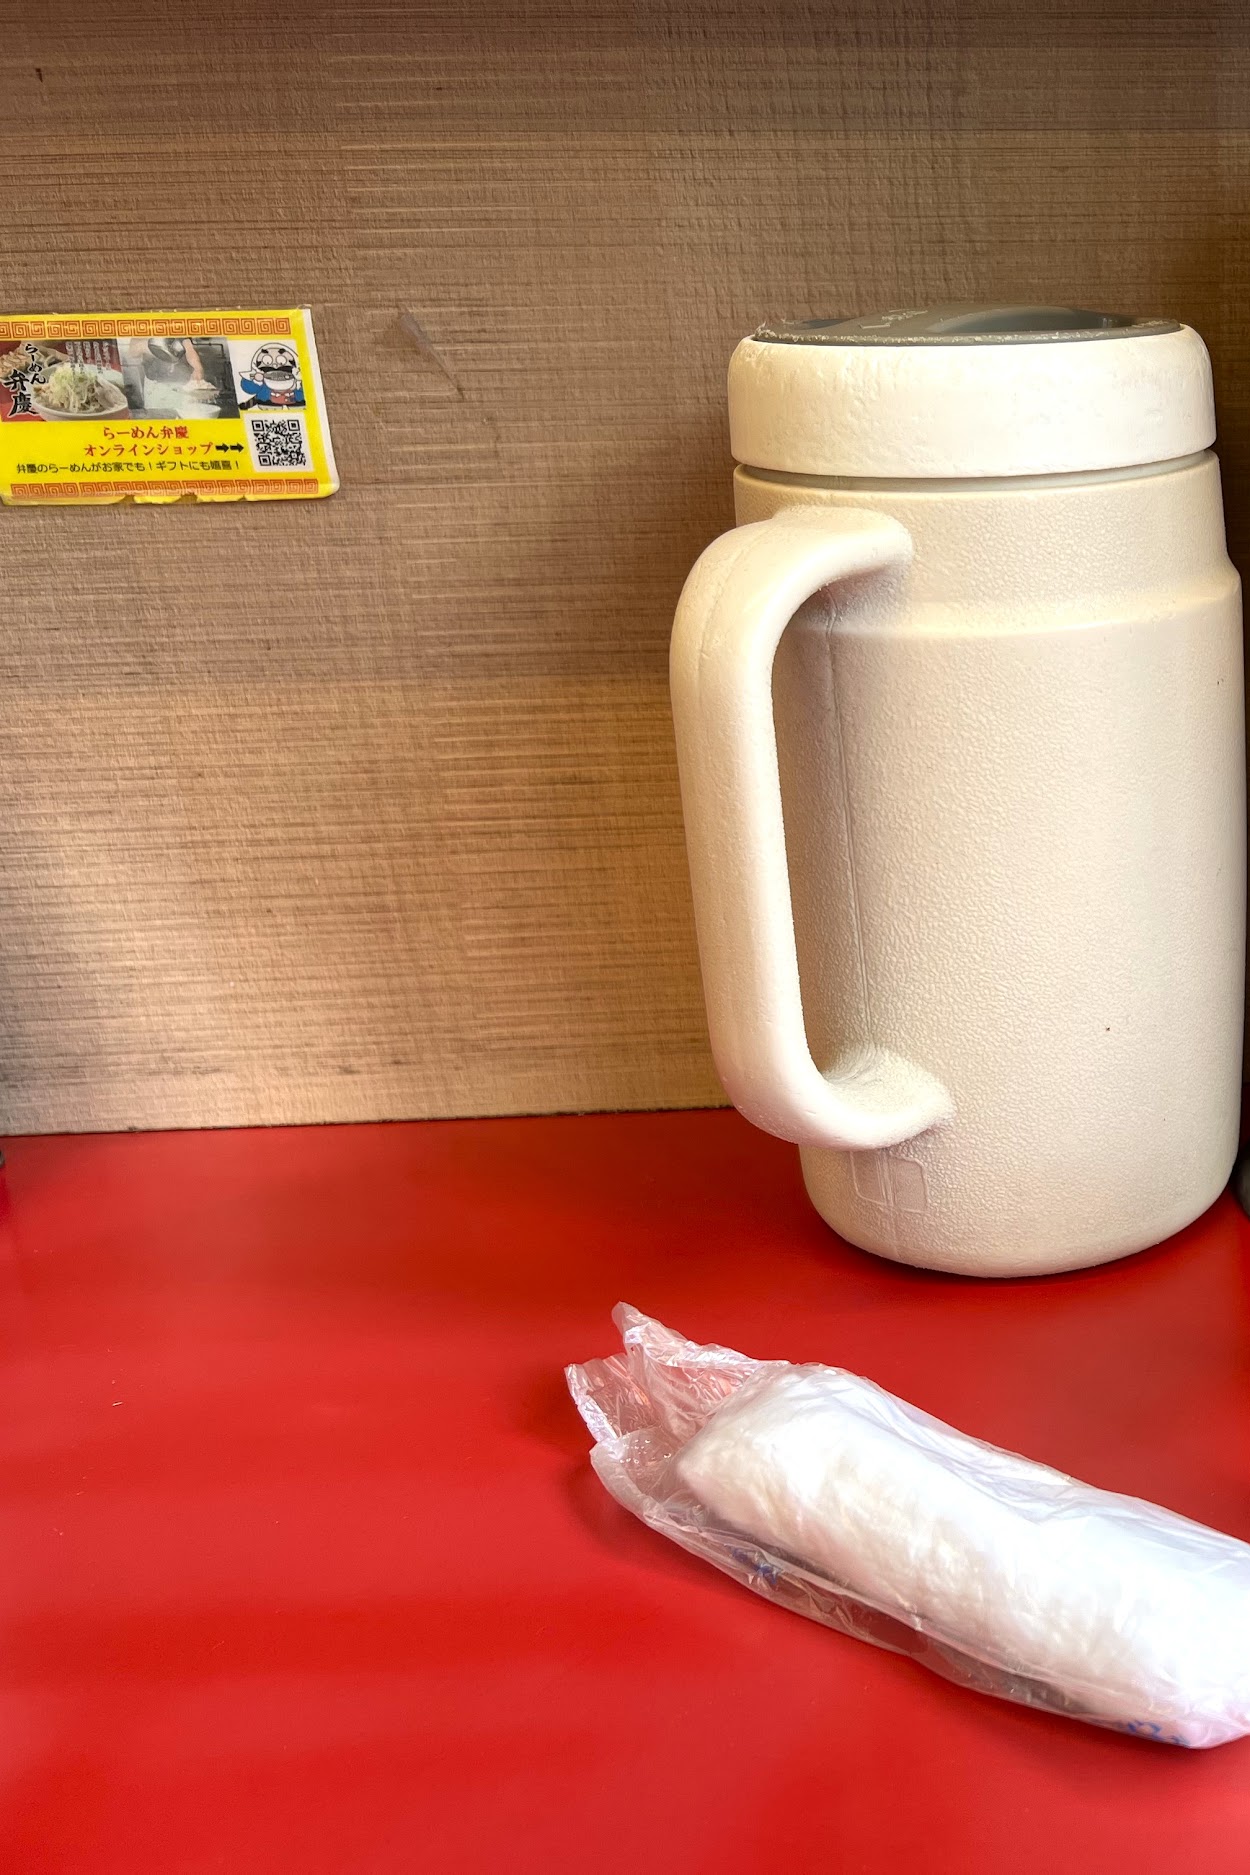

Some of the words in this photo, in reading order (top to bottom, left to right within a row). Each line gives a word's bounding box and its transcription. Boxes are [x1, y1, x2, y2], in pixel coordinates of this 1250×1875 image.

[25, 343, 46, 384] らーめん
[3, 368, 40, 417] 弁慶
[103, 426, 190, 440] らーめん弁慶
[84, 442, 214, 457] オンラインショップ
